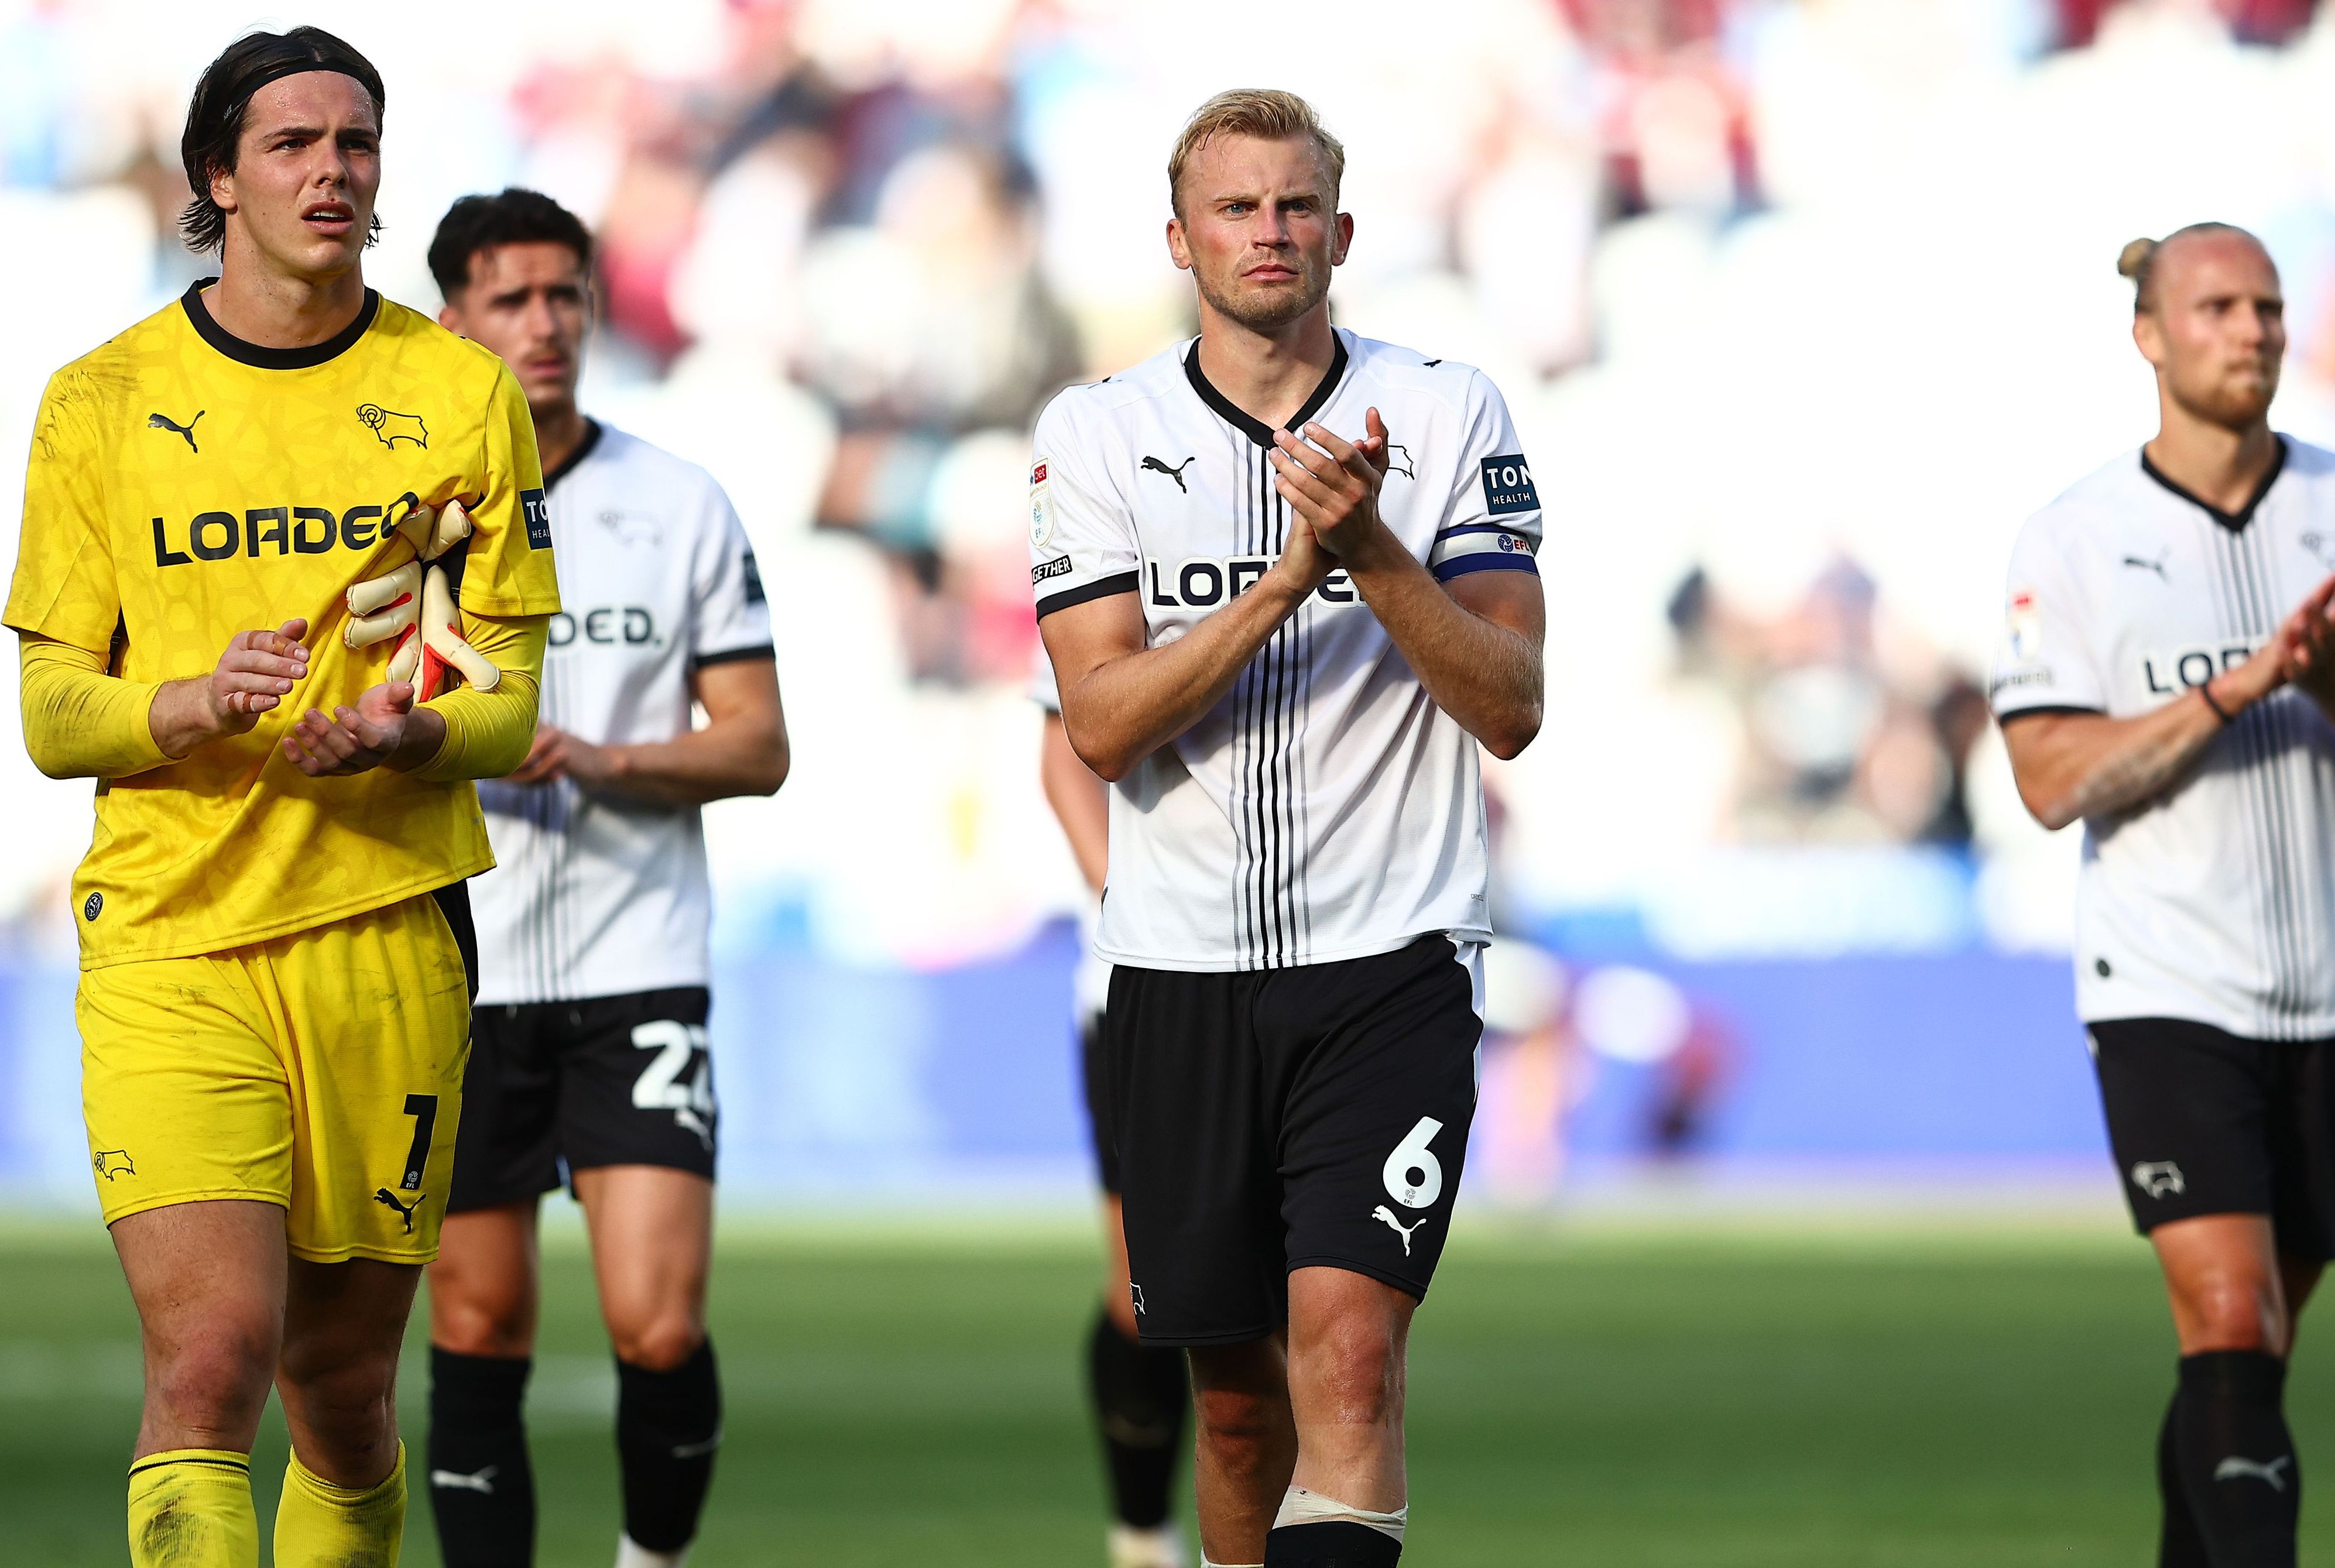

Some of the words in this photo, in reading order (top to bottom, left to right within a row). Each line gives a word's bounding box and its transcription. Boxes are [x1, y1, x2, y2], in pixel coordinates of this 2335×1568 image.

[1493, 492, 1531, 505] HEALTH
[1036, 527, 1045, 538] EFL
[1514, 539, 1530, 551] EFL
[1033, 558, 1070, 583] GETHER
[400, 1094, 438, 1190] 1
[1383, 1116, 1443, 1208] 6
